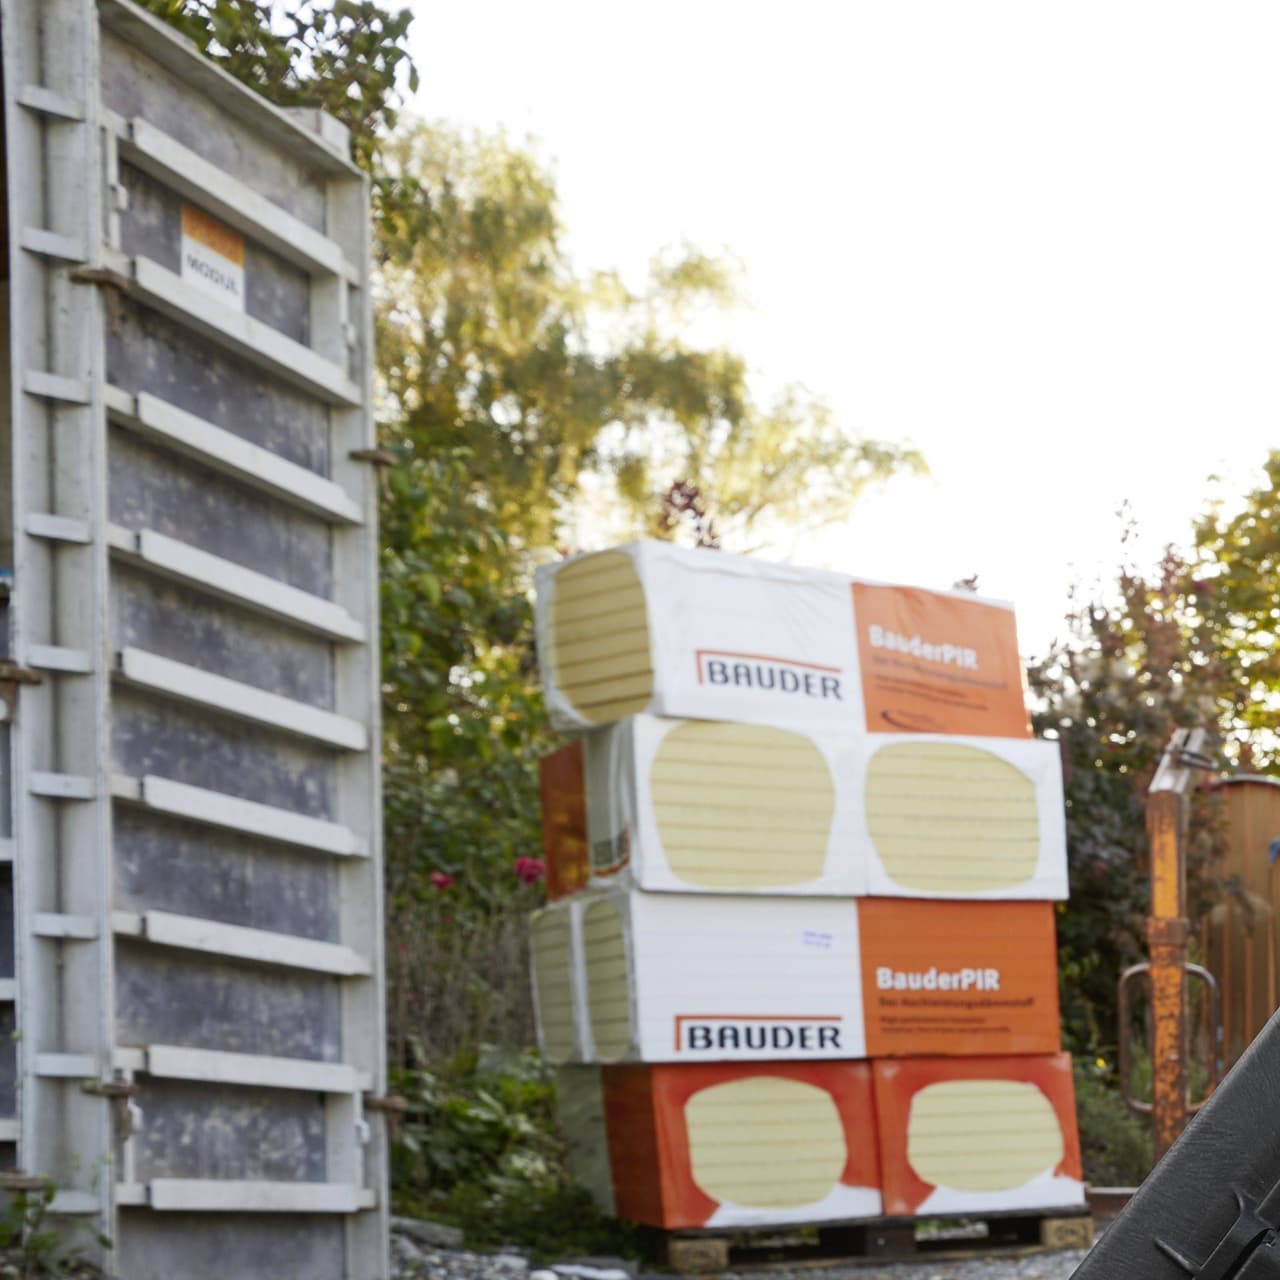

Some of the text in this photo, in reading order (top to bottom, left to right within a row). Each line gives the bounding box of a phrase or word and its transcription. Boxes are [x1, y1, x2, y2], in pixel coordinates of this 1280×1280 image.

[868, 623, 979, 671] BauderPIR
[707, 660, 843, 701] BAUDER
[876, 966, 1000, 991] BauderPIR
[688, 1025, 842, 1051] BAUDER
